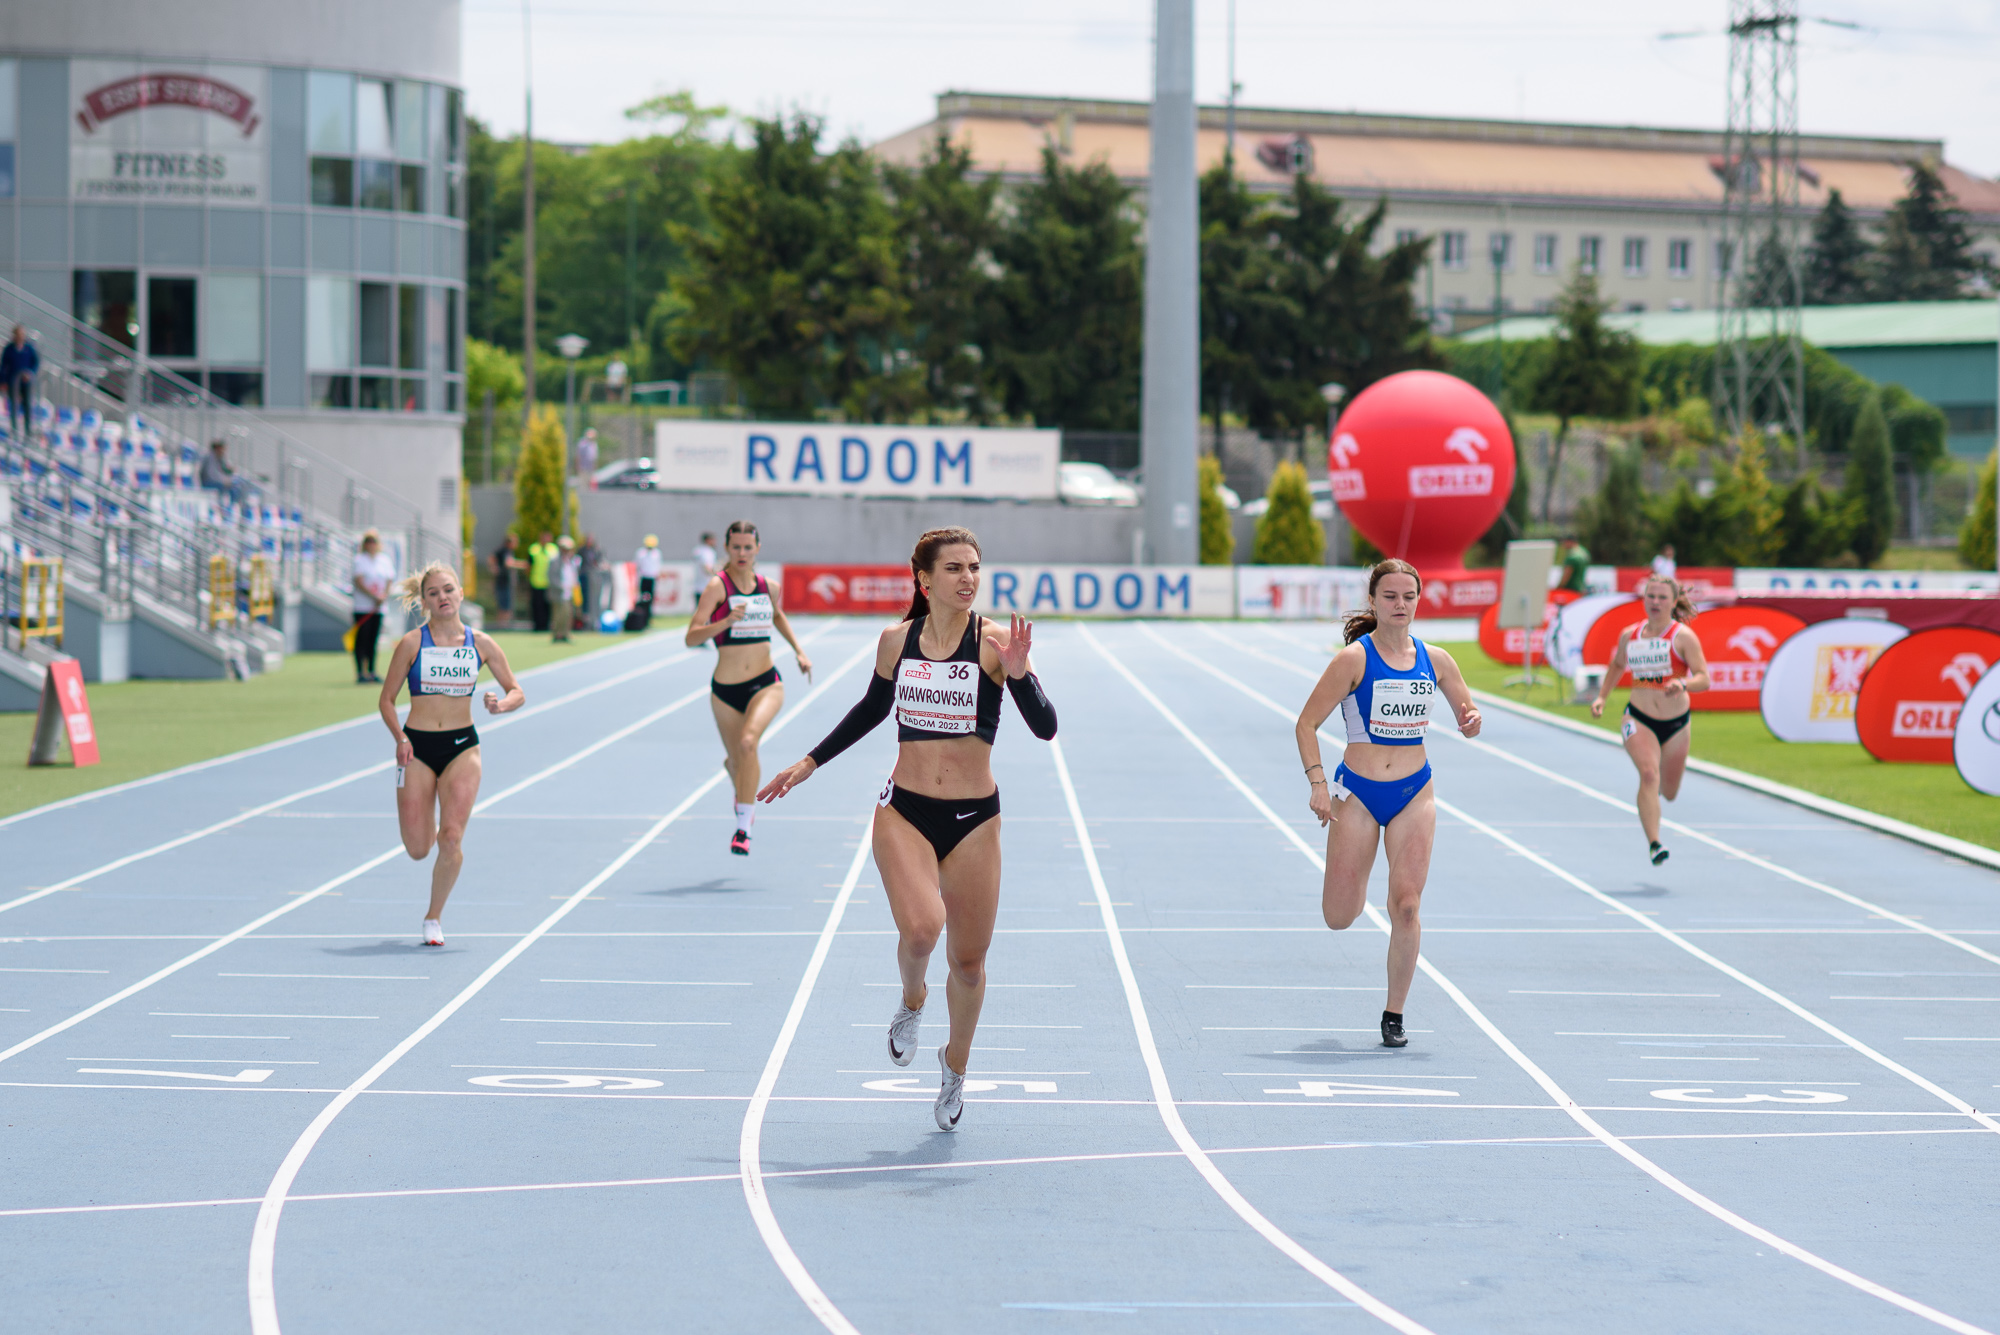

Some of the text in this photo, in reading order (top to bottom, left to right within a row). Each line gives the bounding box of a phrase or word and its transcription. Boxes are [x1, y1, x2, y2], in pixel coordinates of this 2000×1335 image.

[113, 152, 227, 179] FITNESS
[746, 434, 972, 485] RADOM
[991, 572, 1190, 611] RADOM
[453, 648, 474, 660] 475
[1628, 653, 1668, 665] MASTALERZ
[430, 666, 471, 678] STASIK
[906, 671, 931, 679] ORLEN
[948, 664, 969, 680] 36
[425, 686, 451, 694] RADOM
[898, 684, 974, 707] WAWROWSKA
[1410, 682, 1433, 695] 353
[1381, 703, 1427, 717] GAWEŁ
[1810, 695, 1857, 720] PZL
[904, 716, 959, 730] RADOM 2022
[1374, 727, 1404, 736] RADOM
